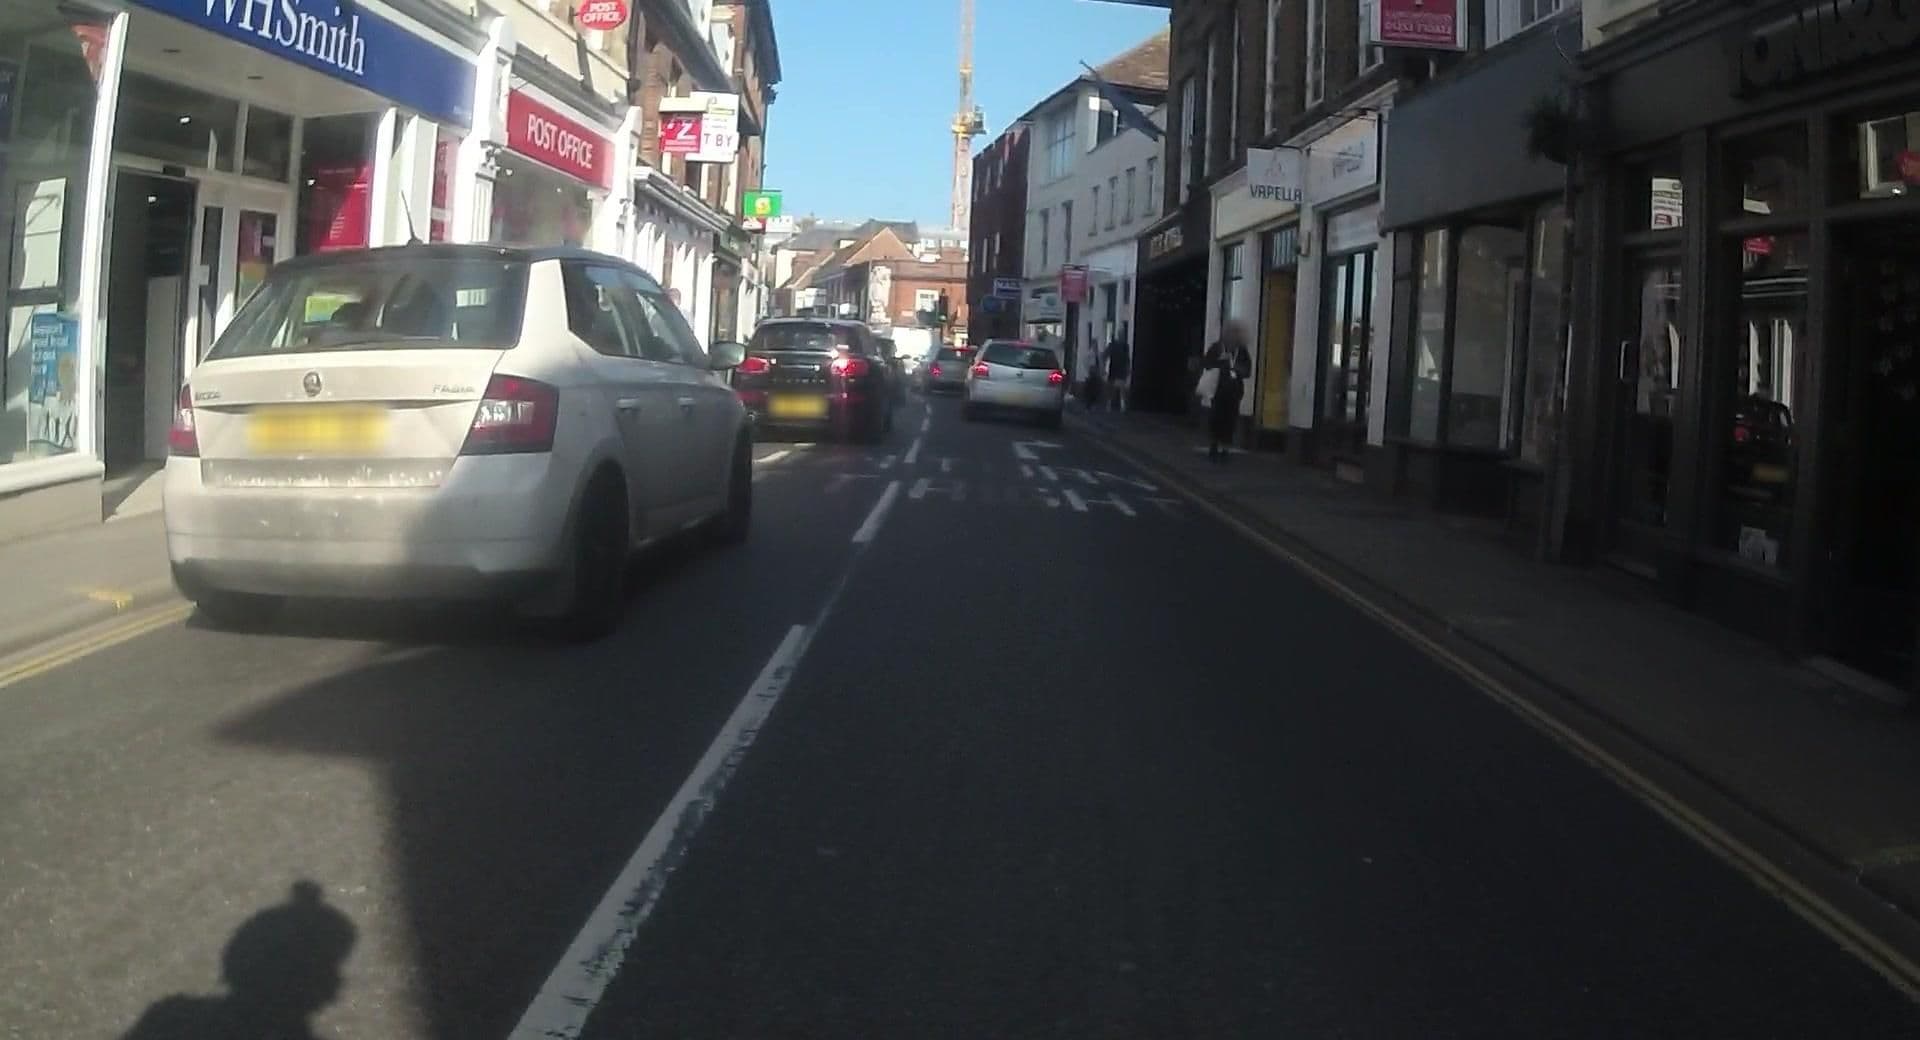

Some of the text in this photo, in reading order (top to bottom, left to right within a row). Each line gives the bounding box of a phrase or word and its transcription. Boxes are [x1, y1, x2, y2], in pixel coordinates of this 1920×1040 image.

[590, 2, 618, 12] POST
[582, 12, 620, 23] OFFICE
[527, 113, 593, 169] POST OFFICE
[1249, 183, 1302, 202] VAPELLA
